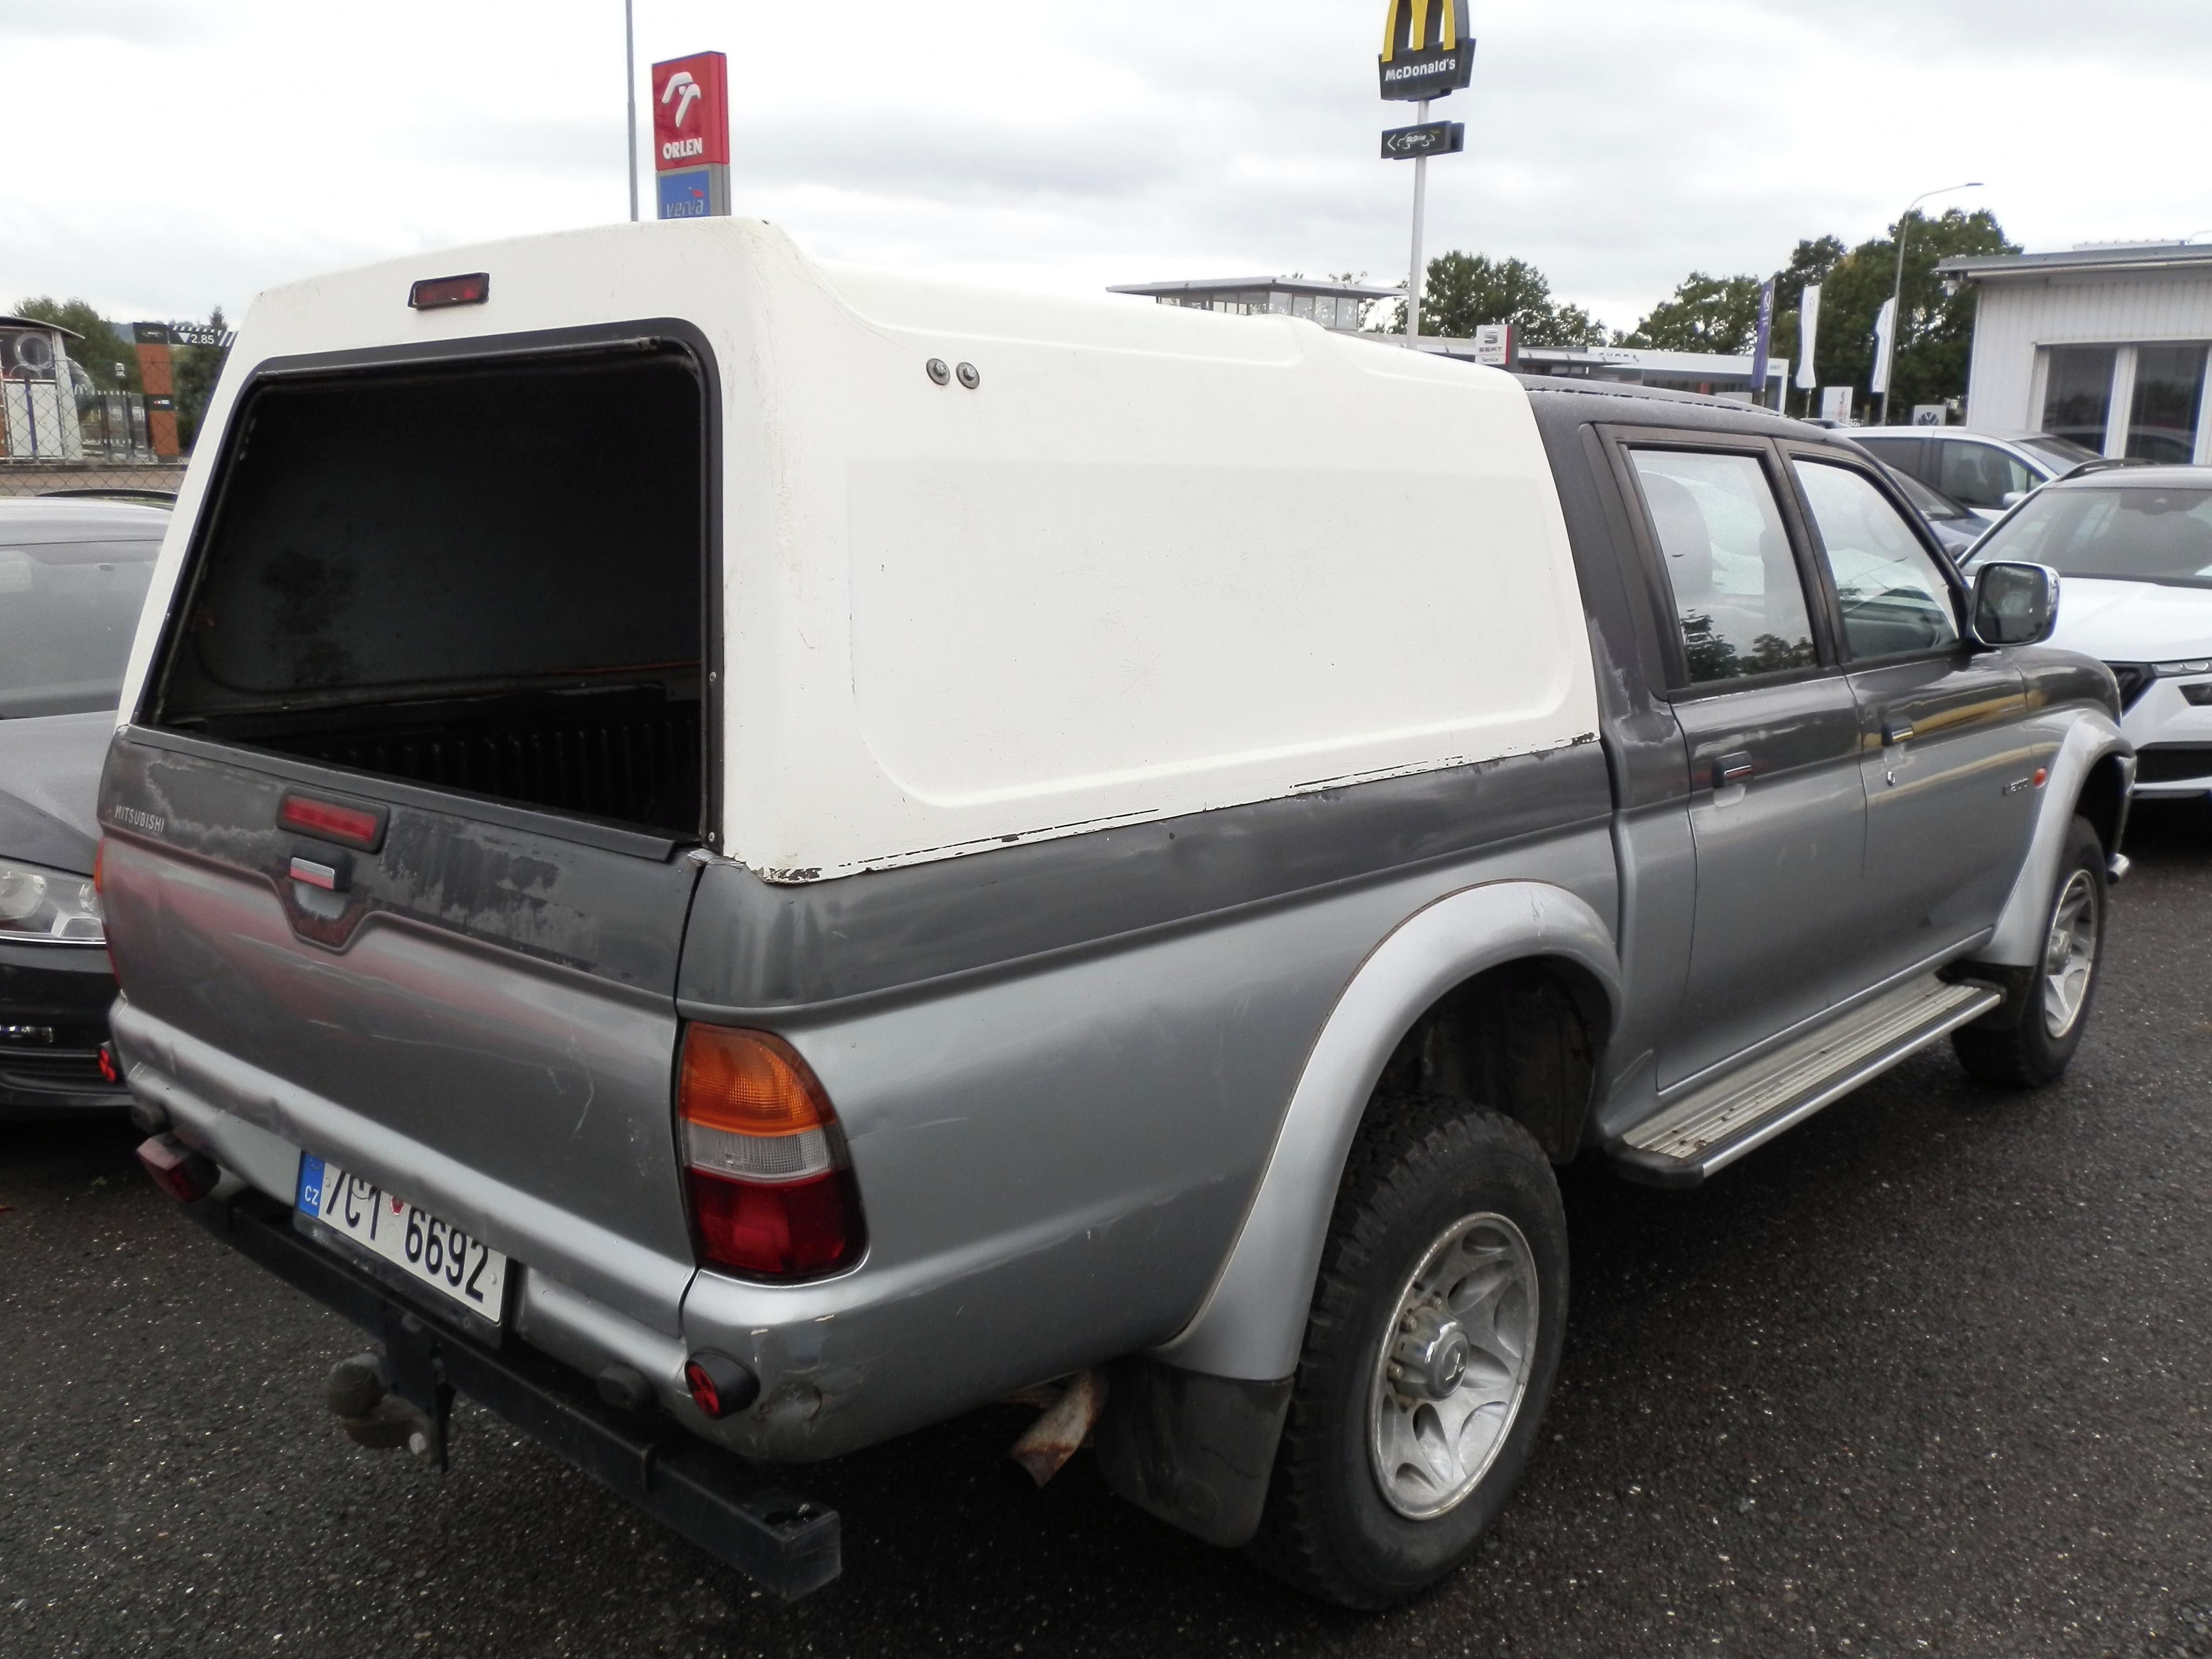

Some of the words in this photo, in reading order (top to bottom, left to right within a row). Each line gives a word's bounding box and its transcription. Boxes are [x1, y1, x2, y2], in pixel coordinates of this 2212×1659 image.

[1385, 58, 1456, 81] McDonald's
[663, 137, 703, 160] ORLEN
[191, 334, 214, 345] 2.85
[114, 805, 164, 832] MITSUBISHI
[305, 1185, 318, 1206] CZ
[404, 1207, 488, 1303] 6692
